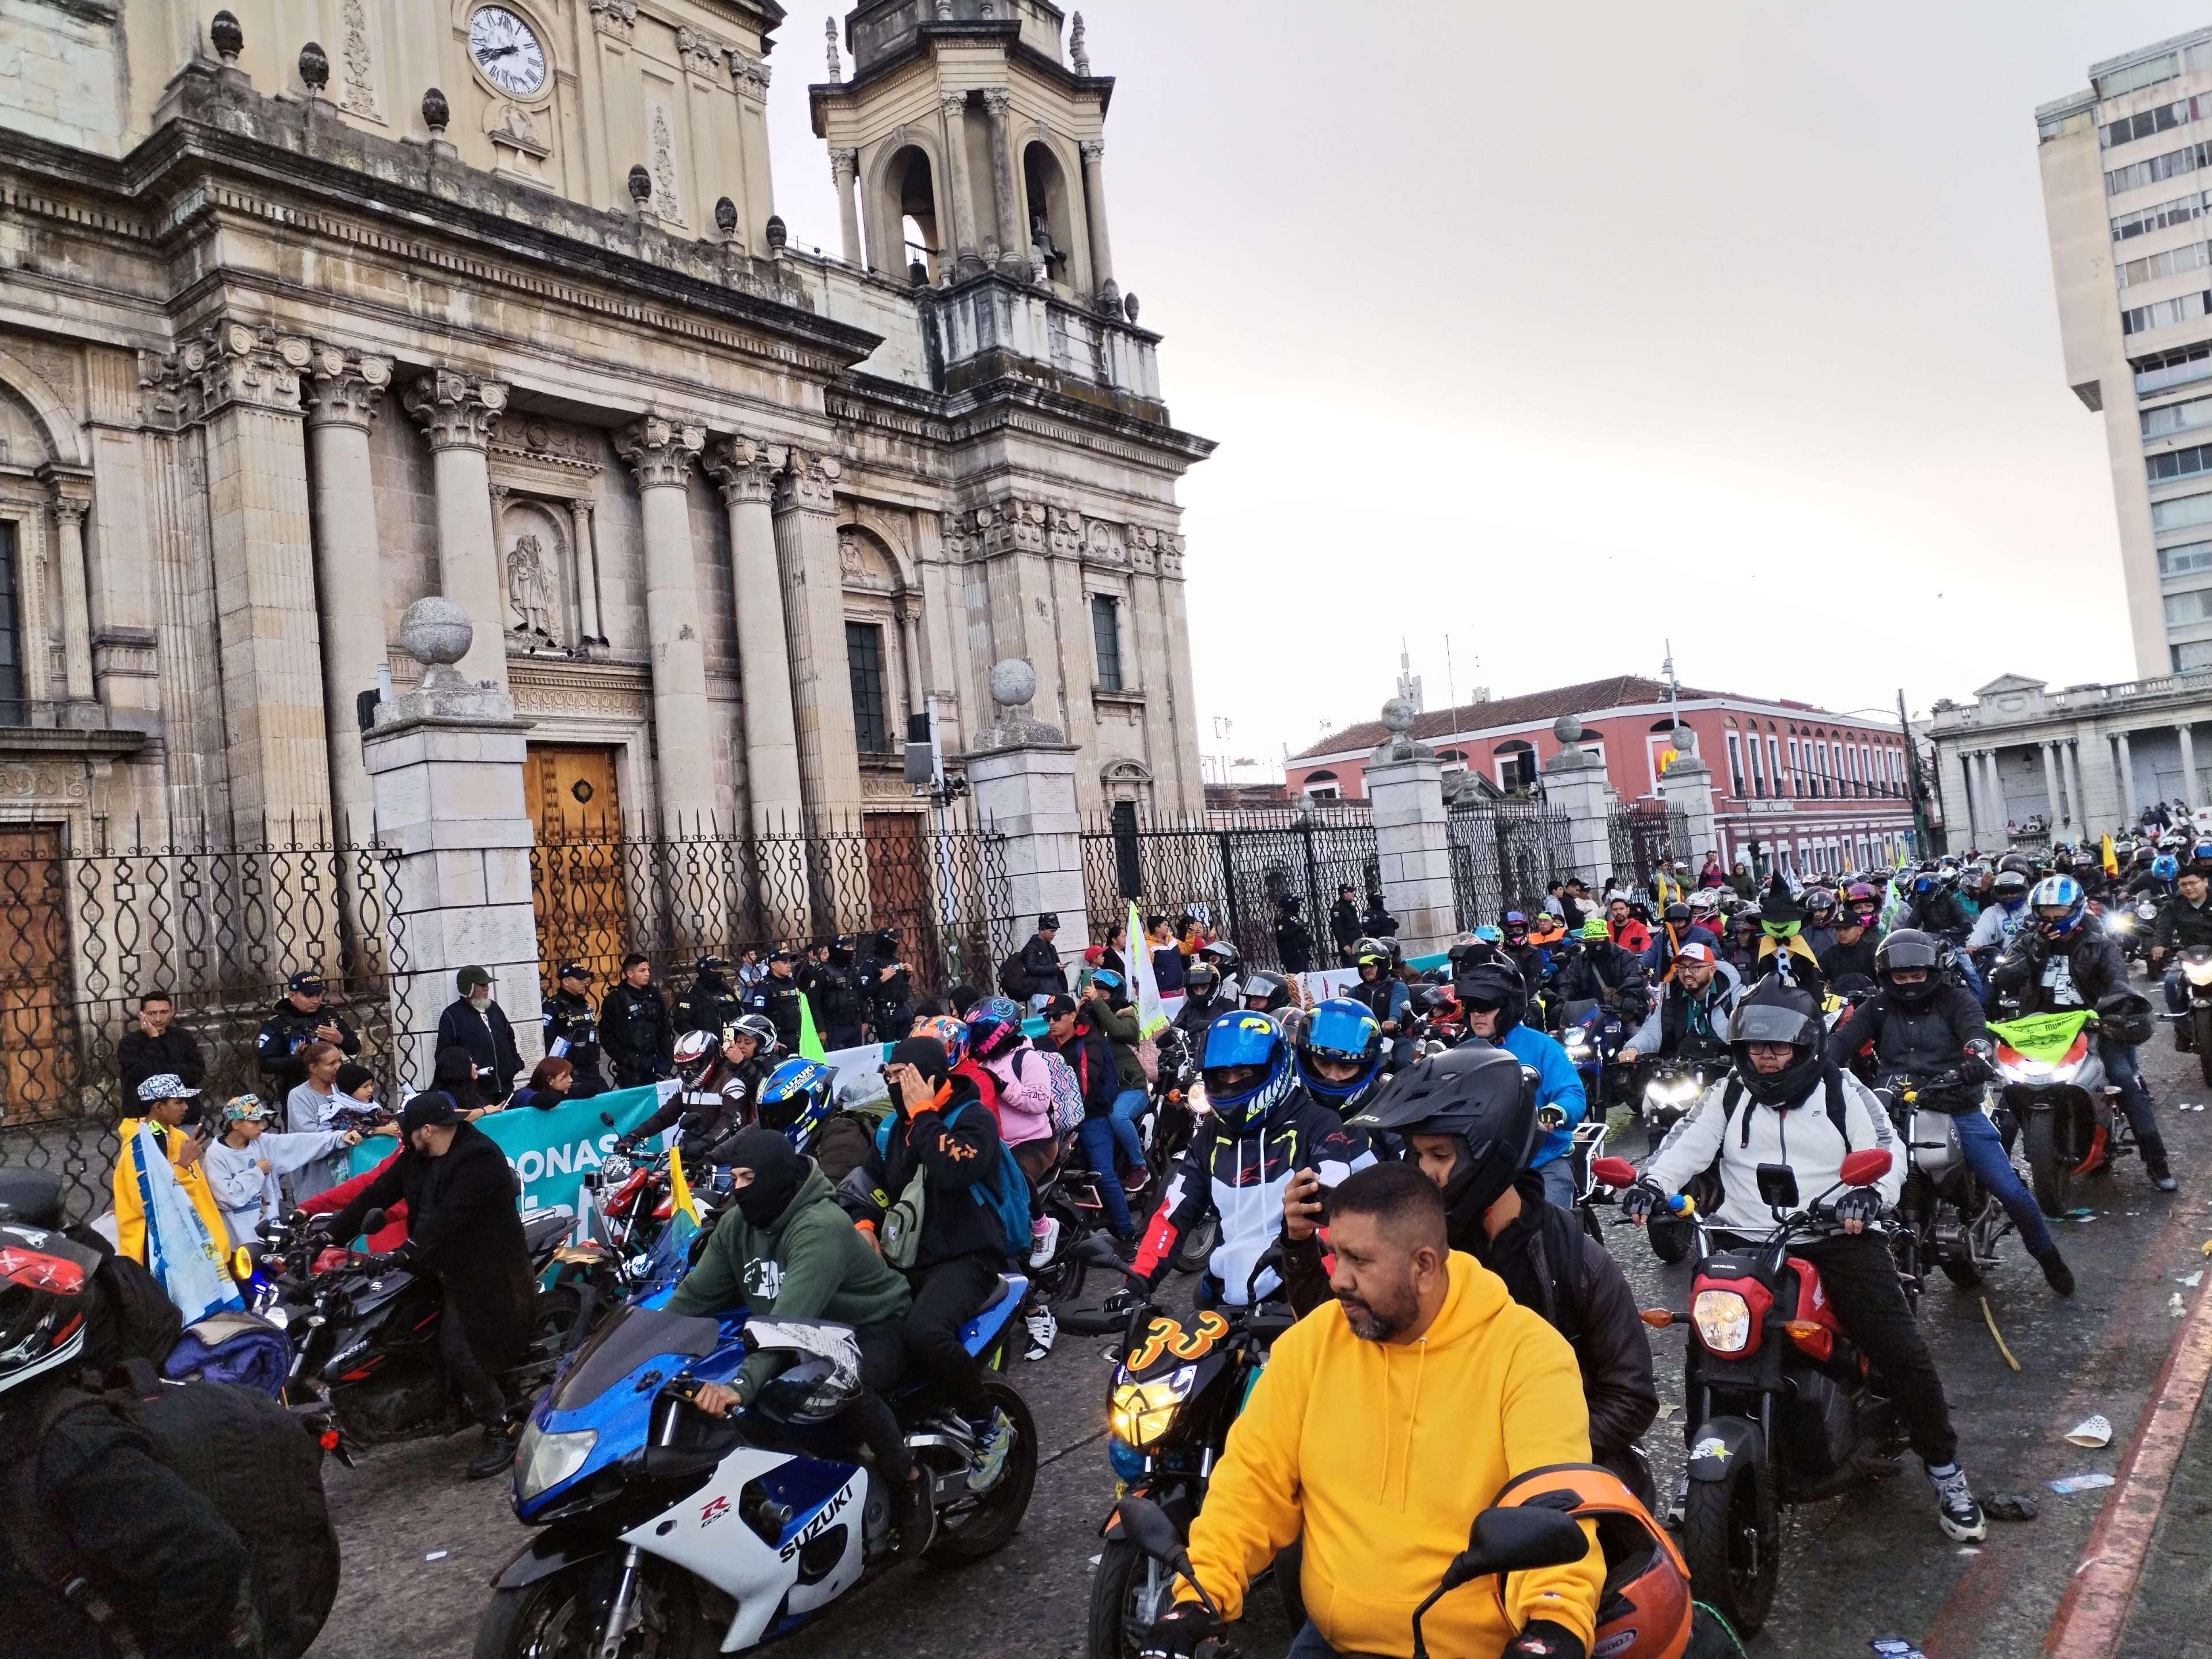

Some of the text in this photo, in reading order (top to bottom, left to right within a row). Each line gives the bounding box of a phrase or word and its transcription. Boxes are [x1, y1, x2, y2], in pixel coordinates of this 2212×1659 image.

[979, 1021, 1010, 1054] PARTY
[779, 1065, 816, 1096] SUZUKI
[1127, 1310, 1229, 1371] 33
[700, 1505, 732, 1529] GSX
[779, 1483, 854, 1563] SUZUKI
